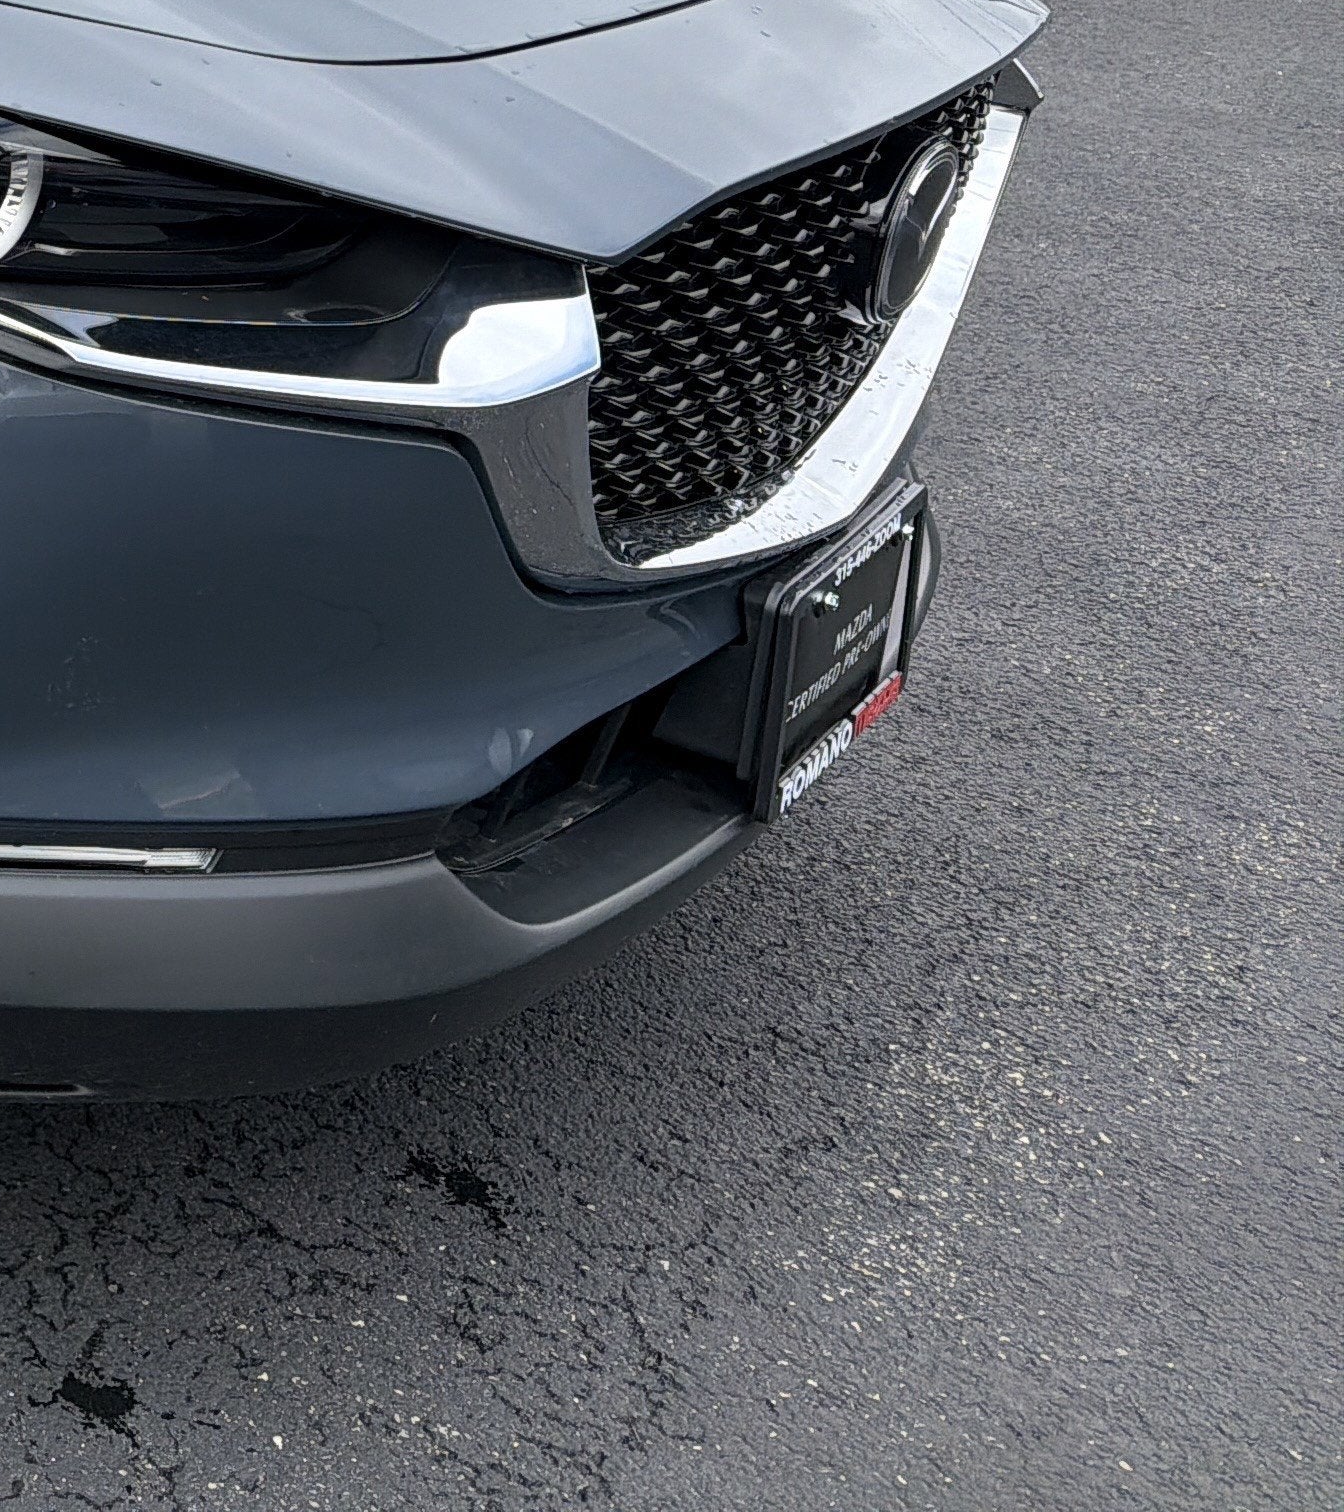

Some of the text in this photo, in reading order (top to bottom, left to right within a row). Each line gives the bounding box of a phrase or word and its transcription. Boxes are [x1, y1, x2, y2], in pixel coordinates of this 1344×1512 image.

[834, 512, 902, 586] 315-446-ZOOM
[785, 609, 892, 723] CERTIFIED PRE-OWN
[832, 603, 873, 656] MAZDA
[779, 719, 854, 813] ROMANO
